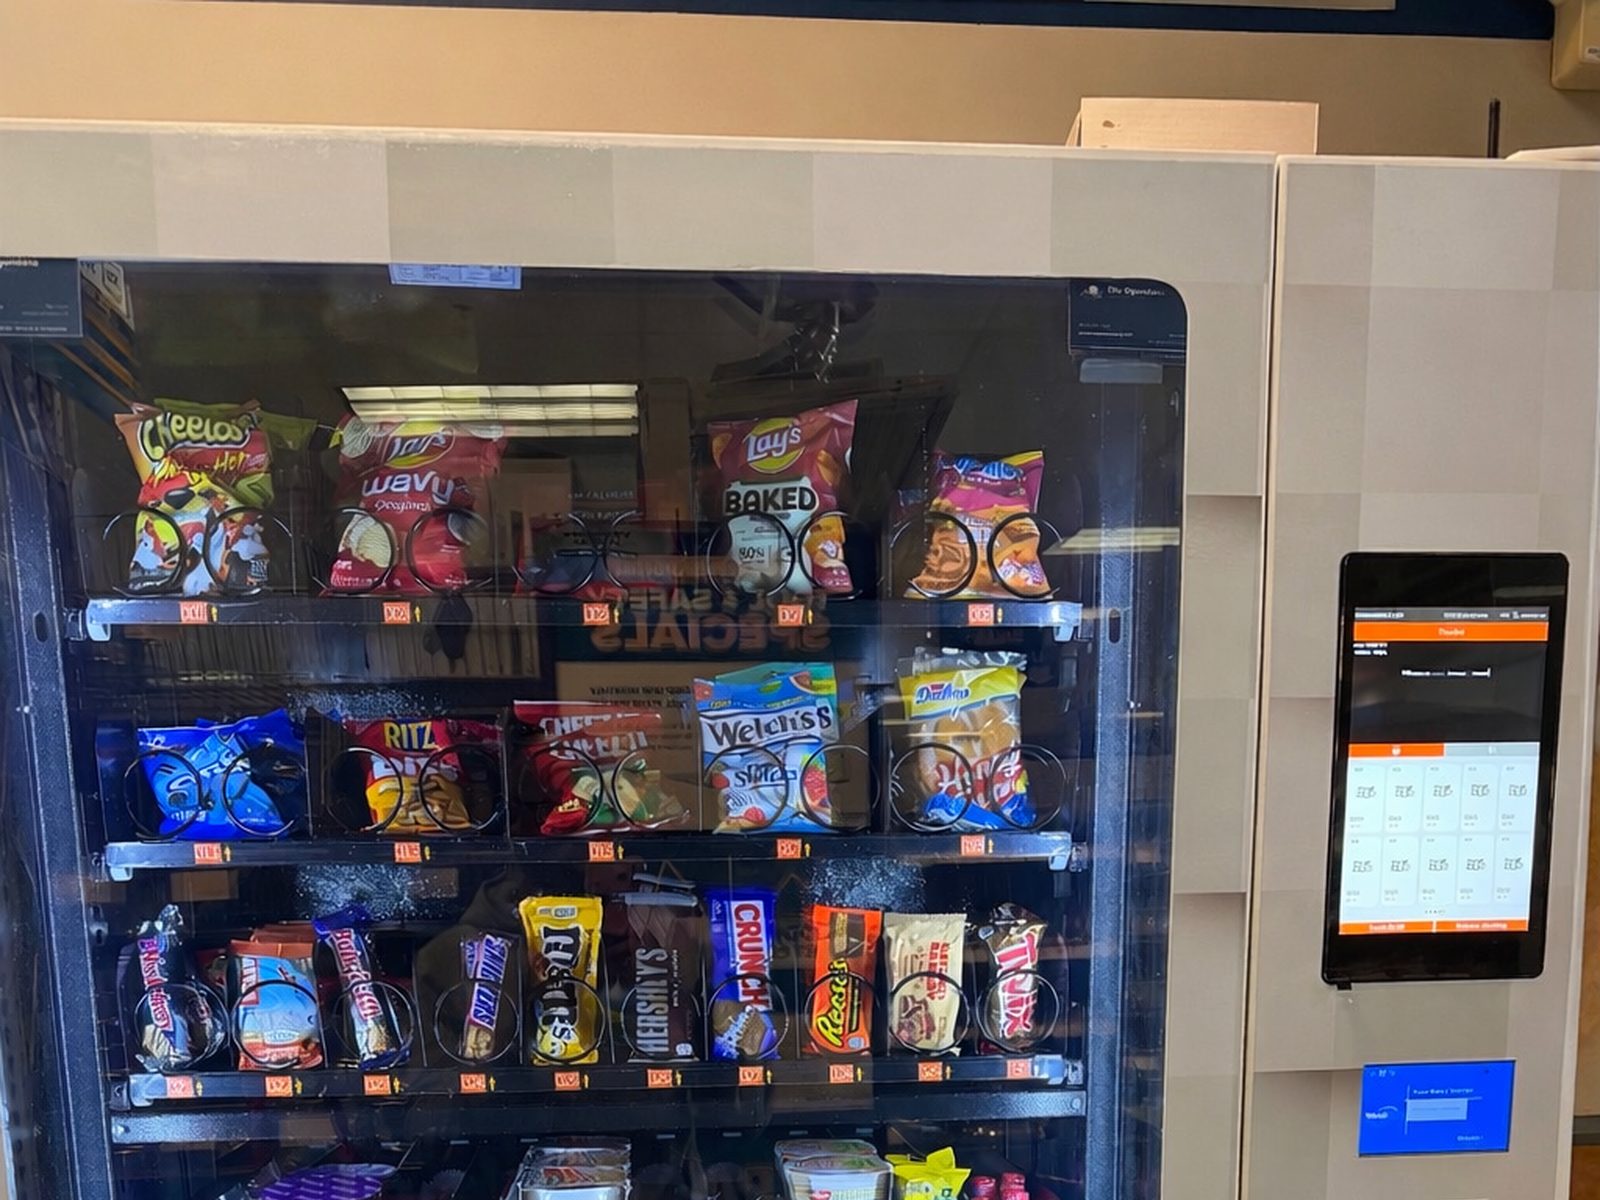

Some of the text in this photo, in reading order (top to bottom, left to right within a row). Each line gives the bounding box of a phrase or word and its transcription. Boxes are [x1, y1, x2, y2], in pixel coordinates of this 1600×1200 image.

[747, 421, 801, 462] Lay's
[724, 486, 818, 514] BAKED
[383, 721, 441, 750] RITZ
[733, 903, 772, 1011] CRUNCH
